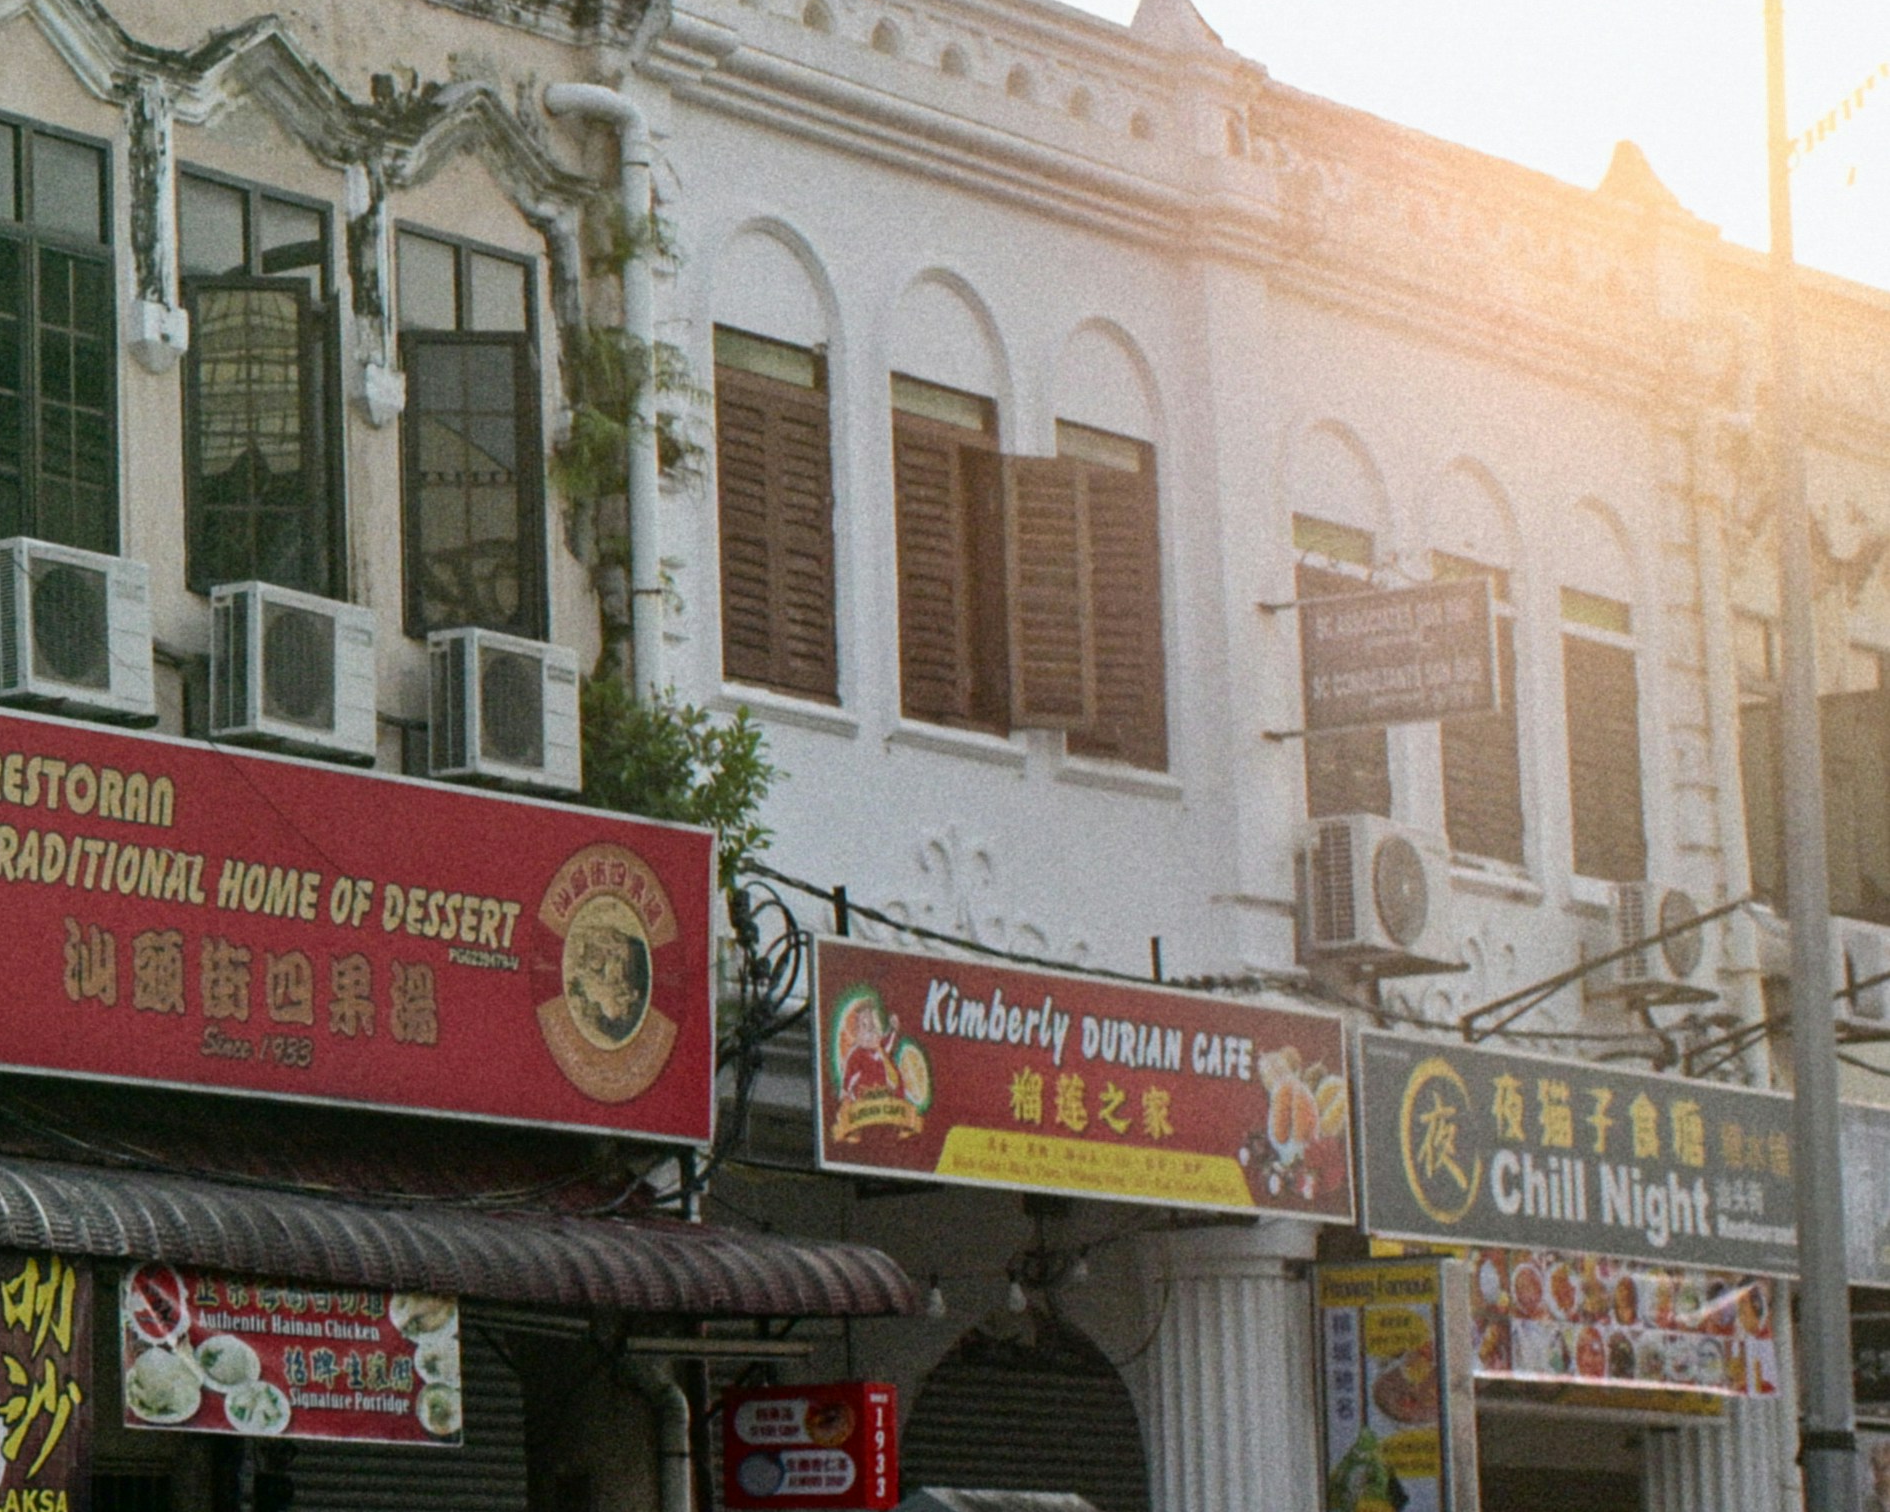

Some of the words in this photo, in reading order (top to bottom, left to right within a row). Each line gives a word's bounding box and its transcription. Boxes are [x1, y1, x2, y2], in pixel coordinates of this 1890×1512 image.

[217, 858, 322, 921] HOME
[330, 875, 374, 927] OF
[382, 883, 521, 949] DESSERT
[258, 1033, 314, 1068] 1933
[922, 977, 1071, 1067] Kimberly
[1081, 1014, 1183, 1072] DURIAN
[1191, 1034, 1254, 1081] CAFE
[1418, 1090, 1469, 1192] 夜
[1490, 1147, 1587, 1222] Chill
[1599, 1163, 1712, 1248] Night
[198, 1309, 268, 1334] Authentic
[271, 1314, 323, 1338] Hainan
[324, 1319, 381, 1342] Chicken
[289, 1387, 353, 1410] Signature
[354, 1391, 411, 1416] Porridge
